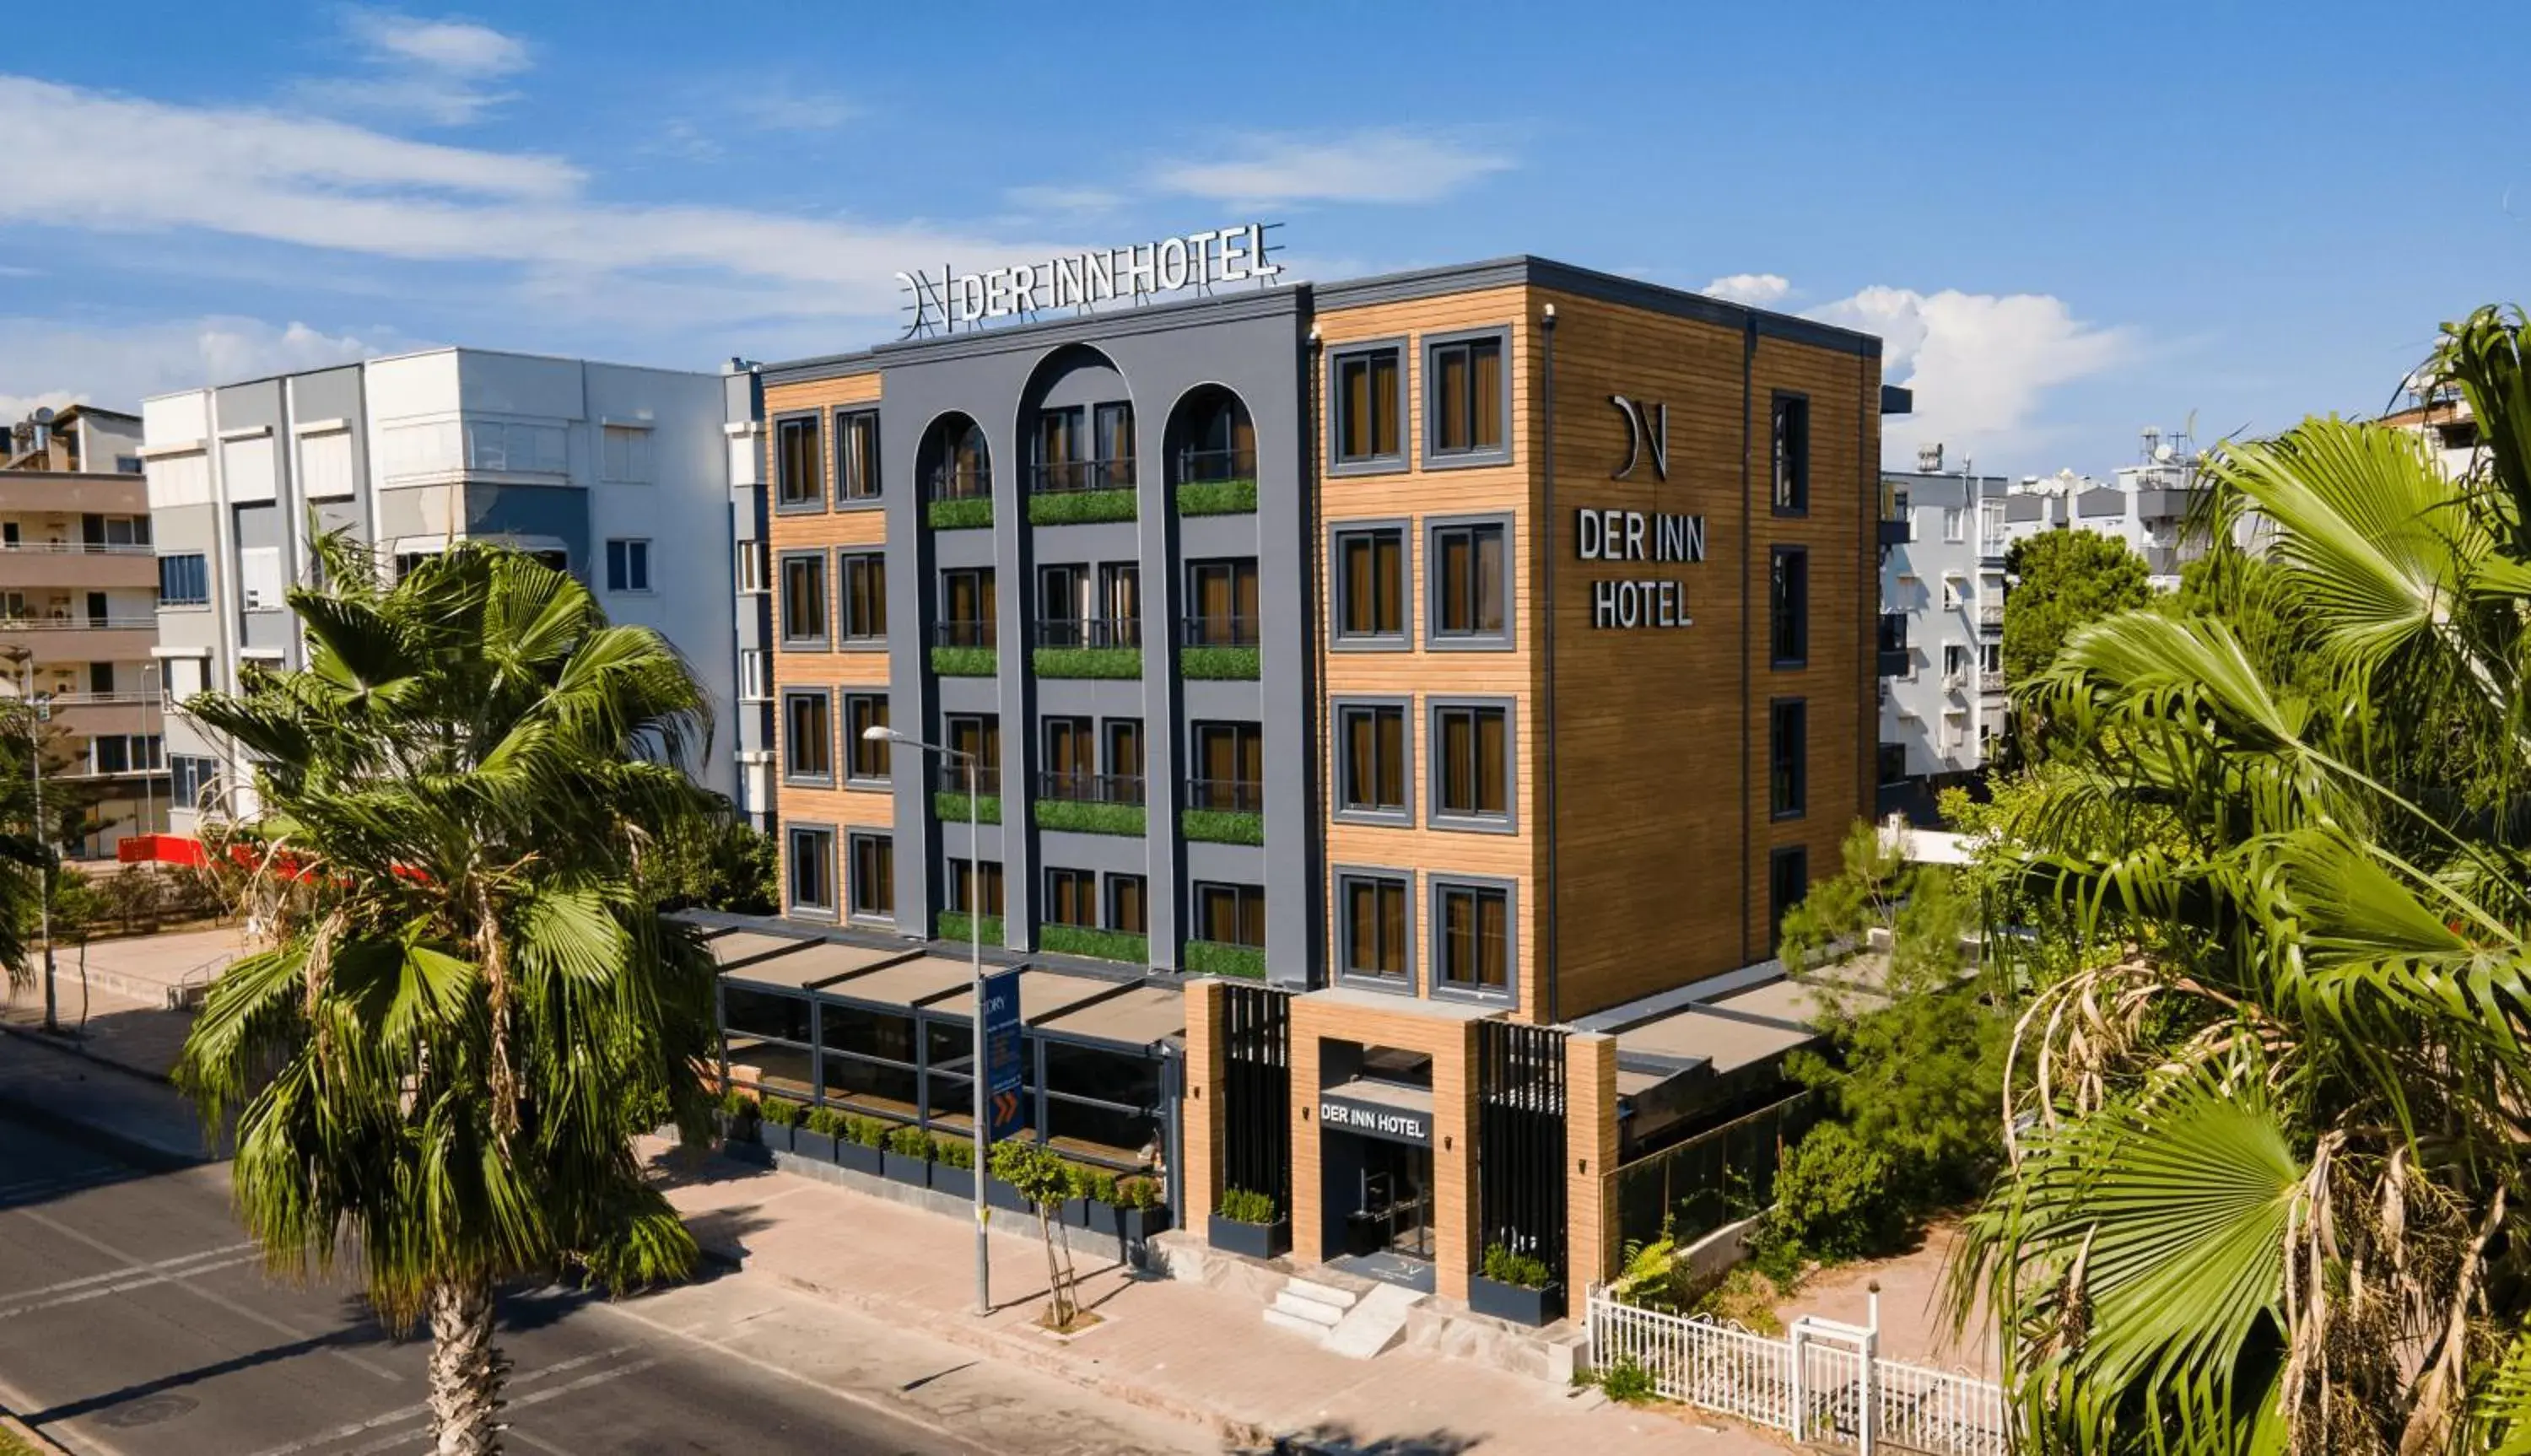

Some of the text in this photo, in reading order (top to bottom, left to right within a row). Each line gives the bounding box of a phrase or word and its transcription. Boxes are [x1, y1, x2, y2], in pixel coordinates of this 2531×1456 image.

[960, 265, 1038, 321] DER
[1049, 248, 1115, 309] INN
[1127, 223, 1279, 294] HOTEL
[1579, 509, 1705, 562] DER INN
[1594, 580, 1693, 628] HOTEL
[1321, 1103, 1425, 1138] DER INN HOTEL
